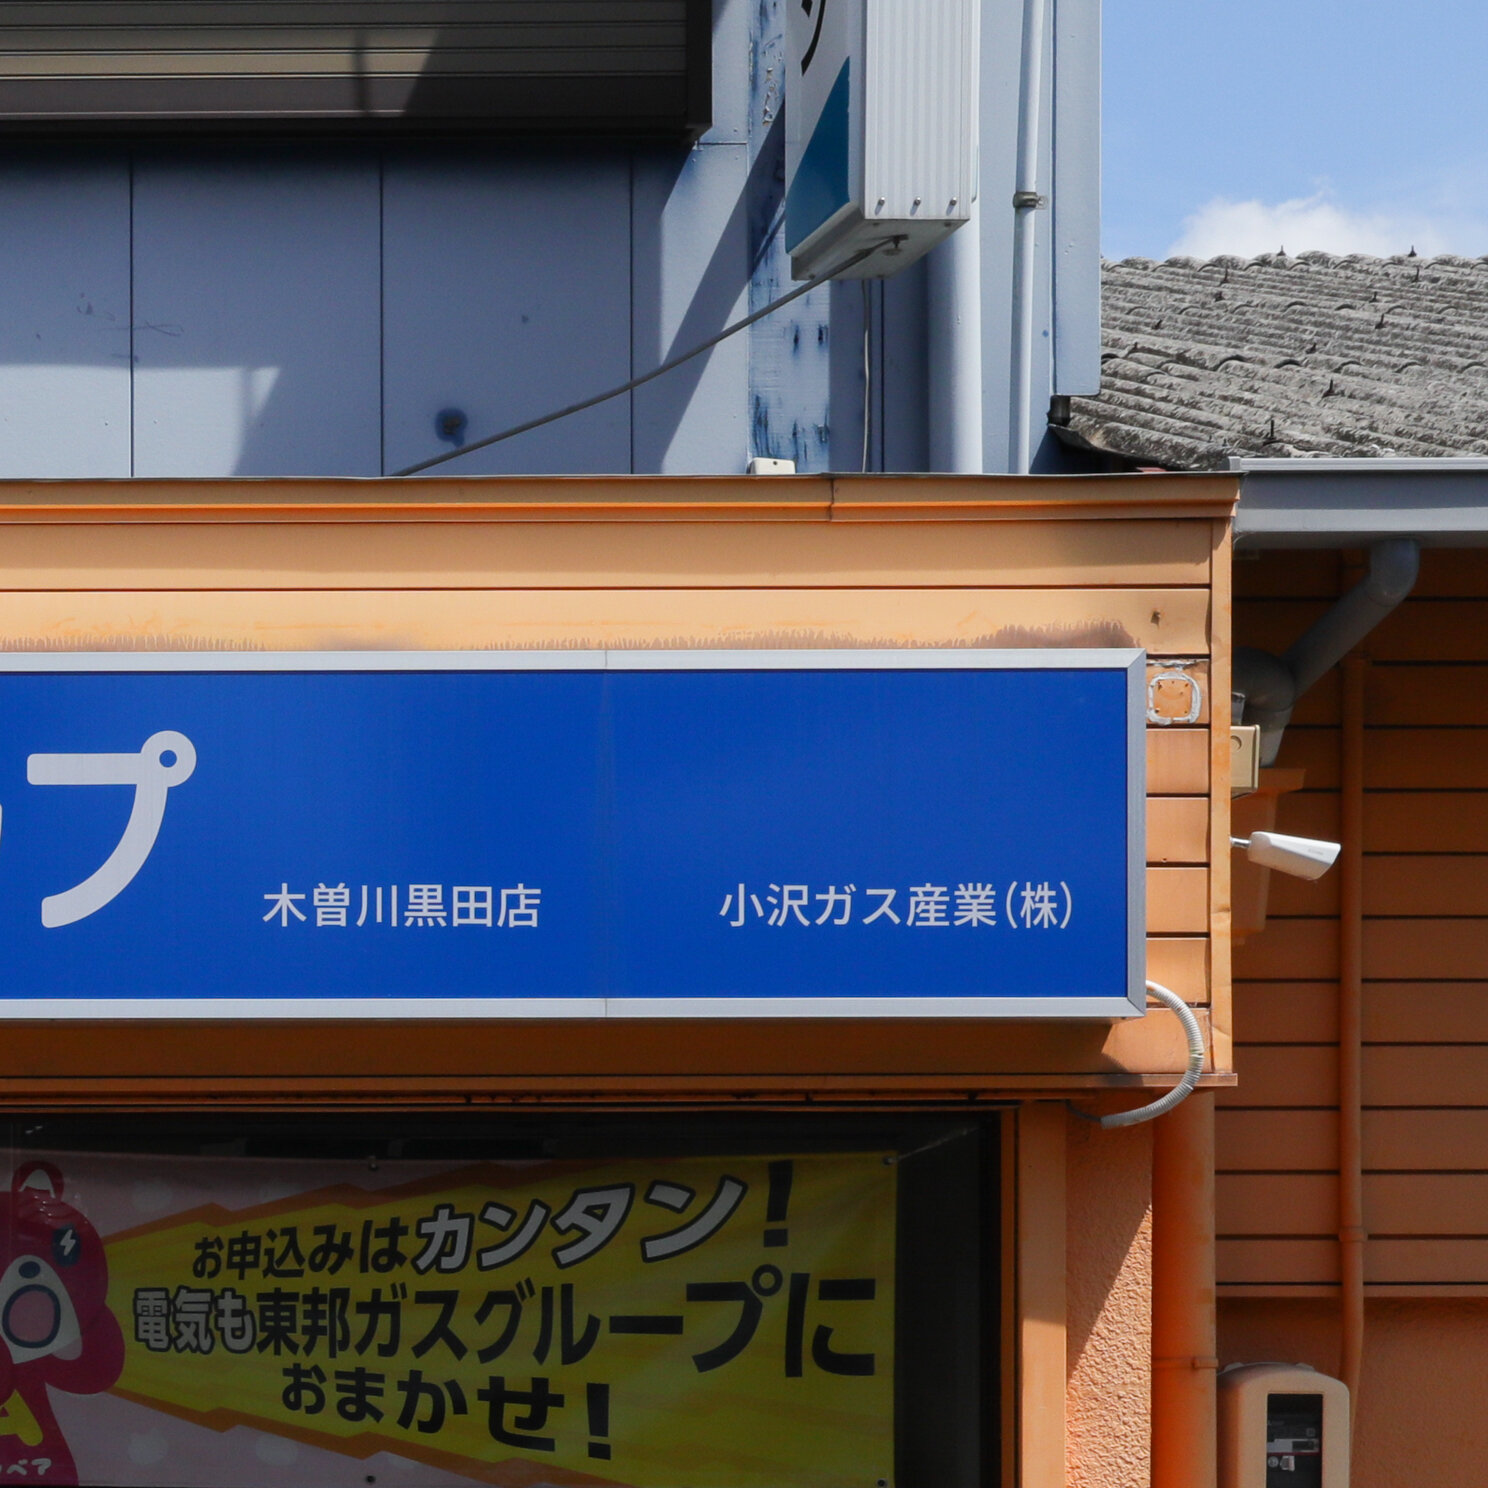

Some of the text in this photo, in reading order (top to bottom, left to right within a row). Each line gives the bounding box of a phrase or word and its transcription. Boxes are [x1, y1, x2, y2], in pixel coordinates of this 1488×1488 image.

[263, 883, 541, 930] 木曽川黒田店
[719, 883, 1076, 932] 小沢ガス産業(株)
[193, 1160, 792, 1282] お申込みはカンタン！
[133, 1263, 877, 1377] 電気も東邦ガスグループに
[281, 1363, 612, 1461] おまかせ！
